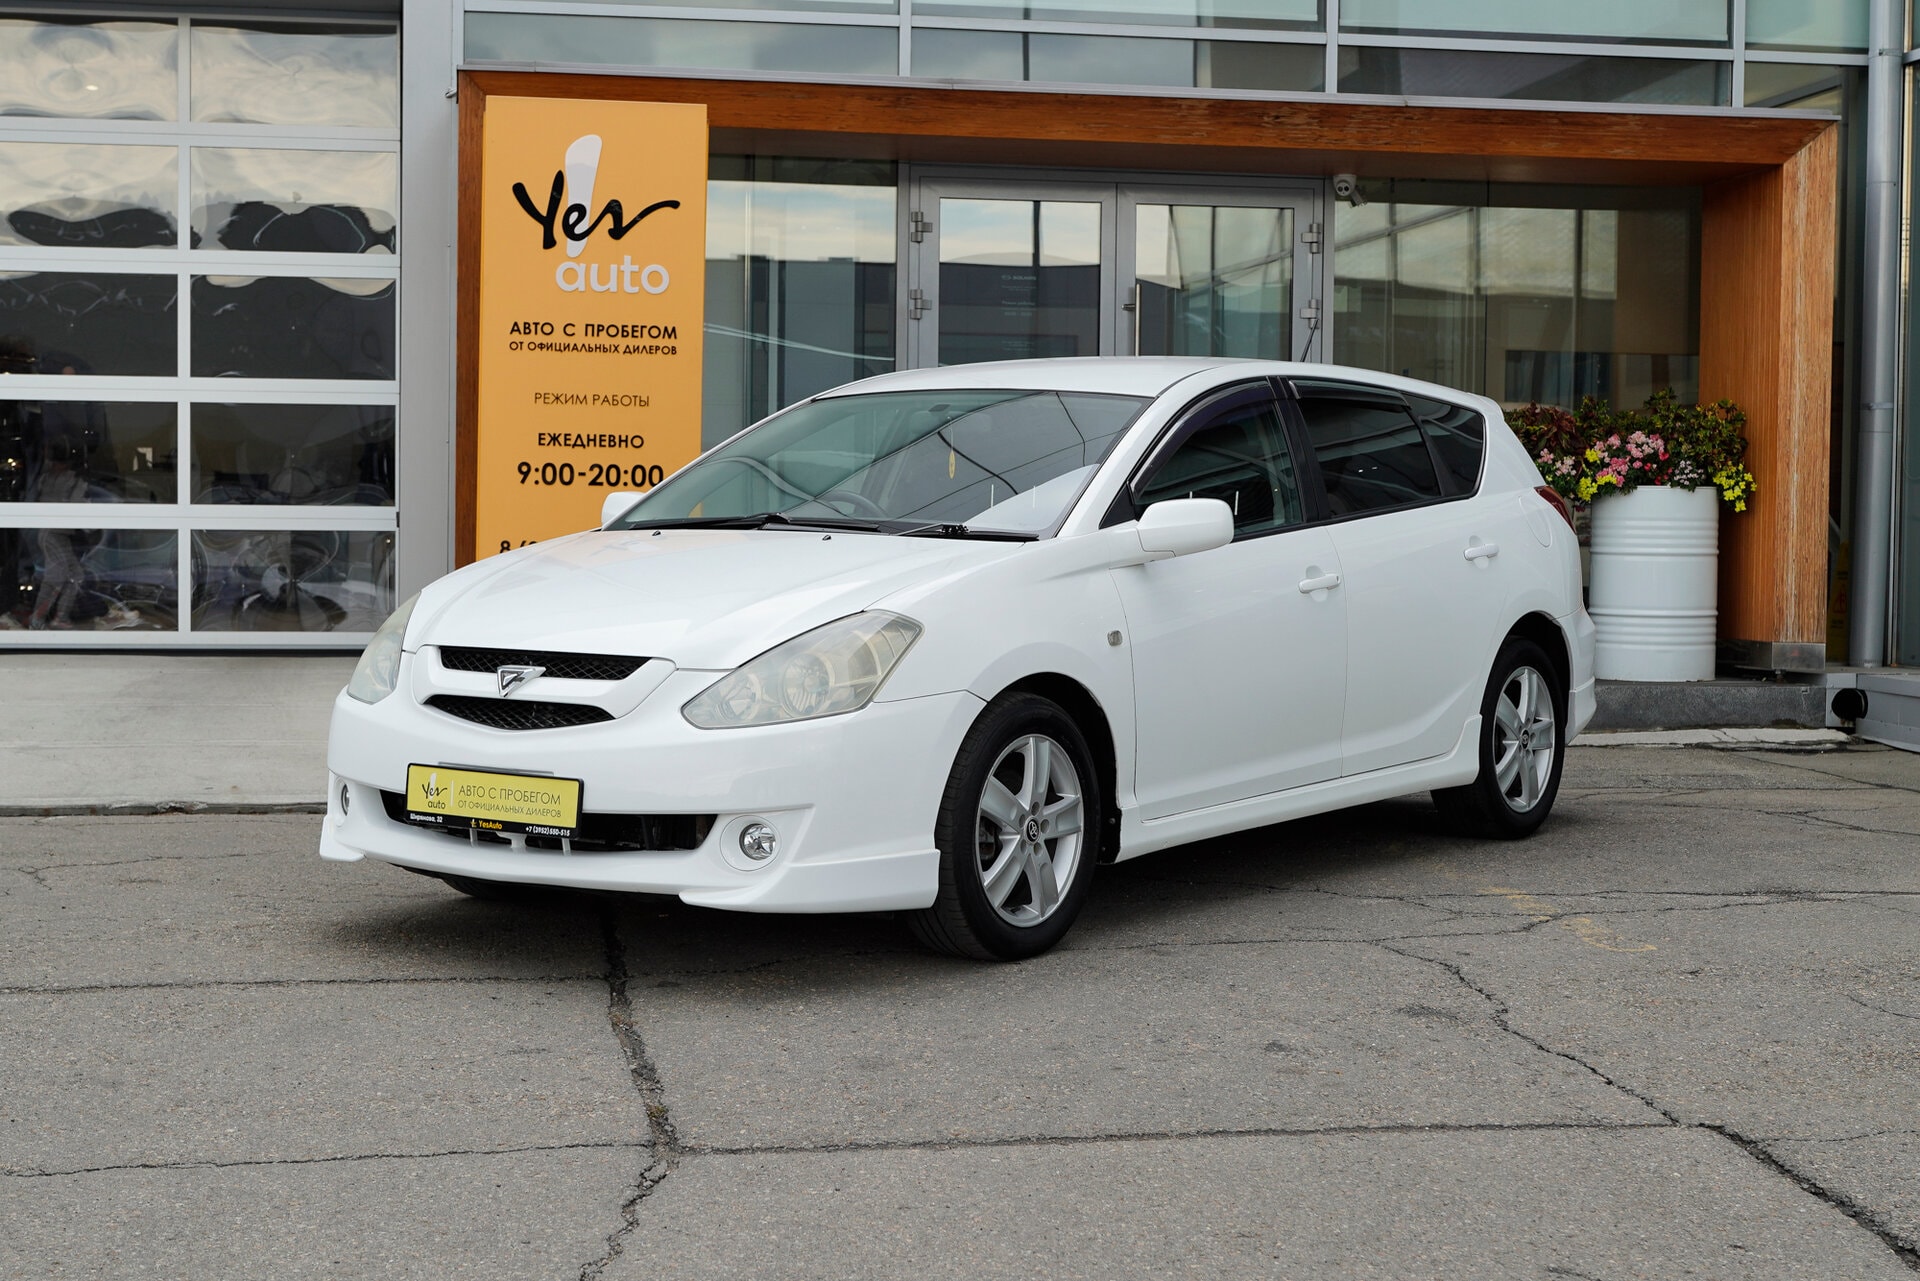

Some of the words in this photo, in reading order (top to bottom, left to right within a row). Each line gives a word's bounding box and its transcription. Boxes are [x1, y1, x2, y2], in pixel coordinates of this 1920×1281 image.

[512, 170, 681, 250] Yes
[555, 255, 670, 294] auto
[509, 321, 554, 336] АВТО
[563, 323, 576, 337] С
[584, 323, 678, 340] ПРОБЕГОМ
[509, 341, 524, 351] ОТ
[527, 341, 620, 354] ОФИЦИАЛЬНЫХ
[622, 344, 677, 355] ДИЛЕРОВ
[534, 392, 588, 405] РЕЖИМ
[592, 393, 649, 407] РАБОТЫ
[537, 432, 644, 449] ЕЖЕДНЕВНО
[517, 461, 664, 487] 9:00-20:00
[421, 781, 448, 799] Yes
[458, 785, 486, 799] АВТО
[488, 787, 497, 800] С
[500, 788, 561, 806] ПРОБЕГОМ
[427, 800, 446, 810] auto
[458, 799, 467, 809] ОТ
[468, 801, 525, 815] ОФИЦИАЛЬНЫХ
[526, 807, 562, 818] ДИЛЕРОВ
[479, 820, 502, 830] YesAuto
